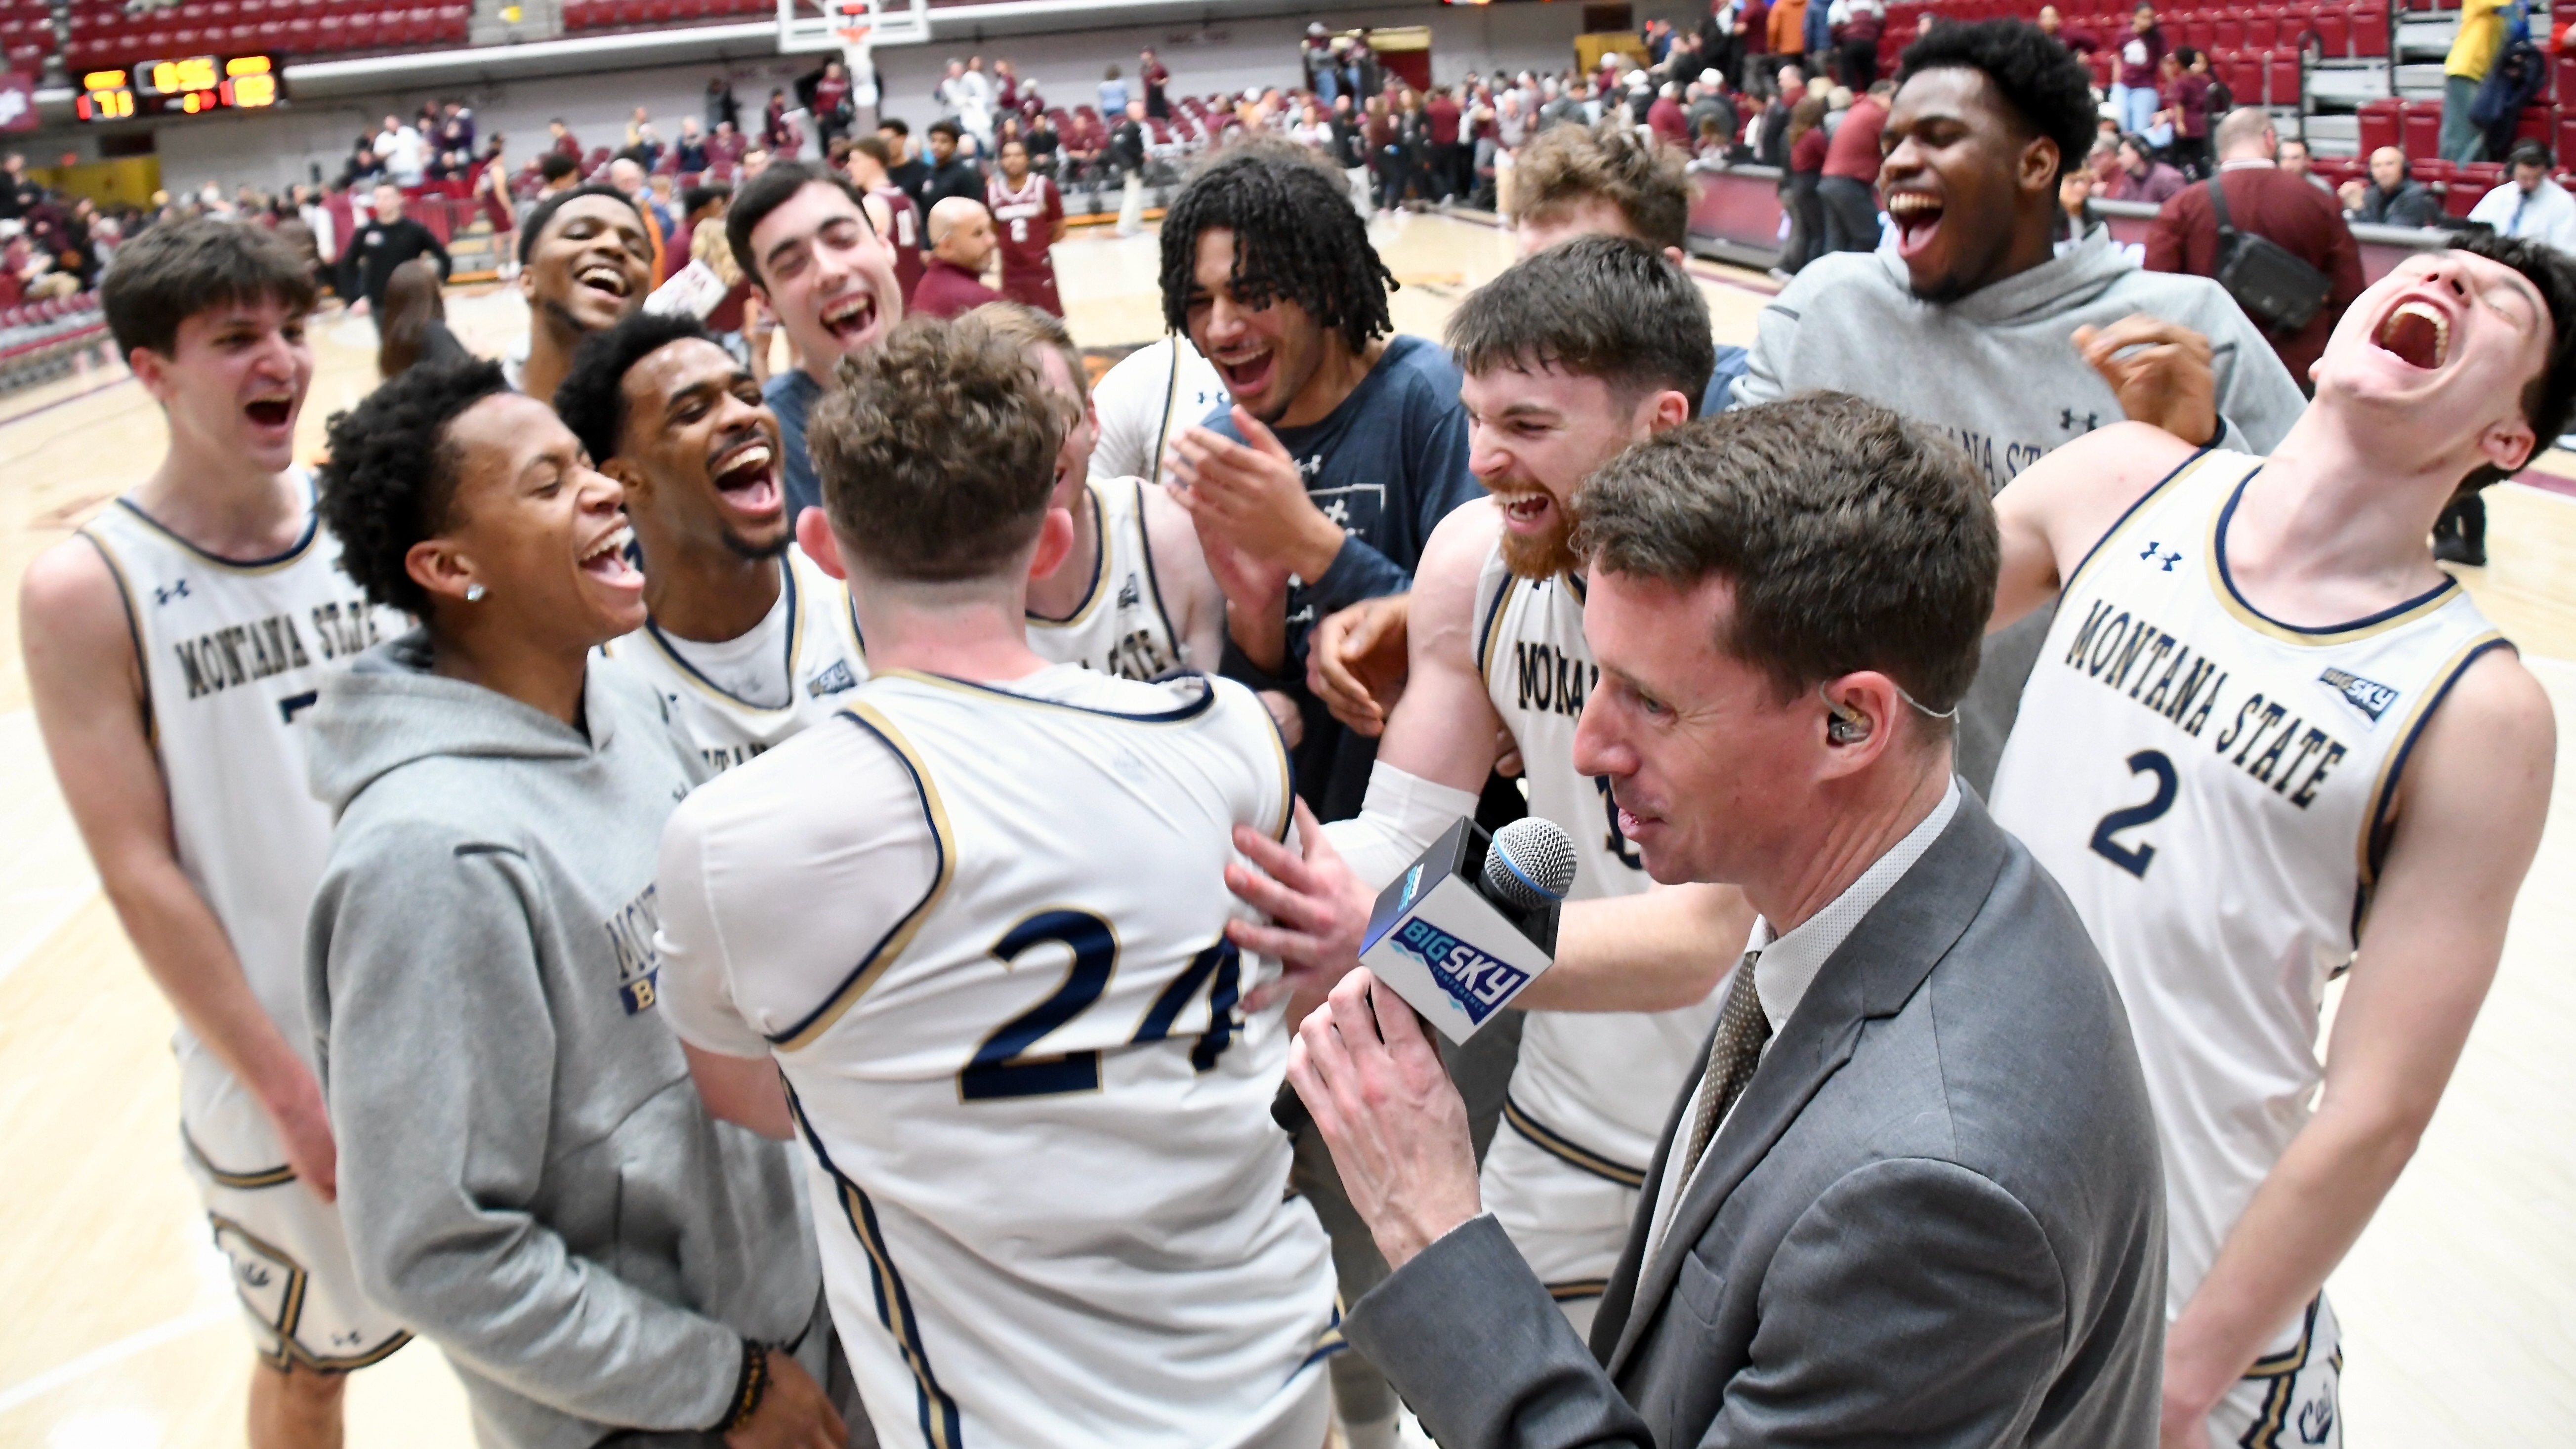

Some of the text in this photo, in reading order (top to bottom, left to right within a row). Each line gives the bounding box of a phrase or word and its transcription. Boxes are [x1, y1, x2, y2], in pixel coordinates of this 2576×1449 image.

[2064, 598, 2348, 811] MONTANA STATE
[2088, 748, 2180, 881] 2
[956, 904, 1246, 1105] 24
[1433, 965, 1487, 1013] CONFERENCE
